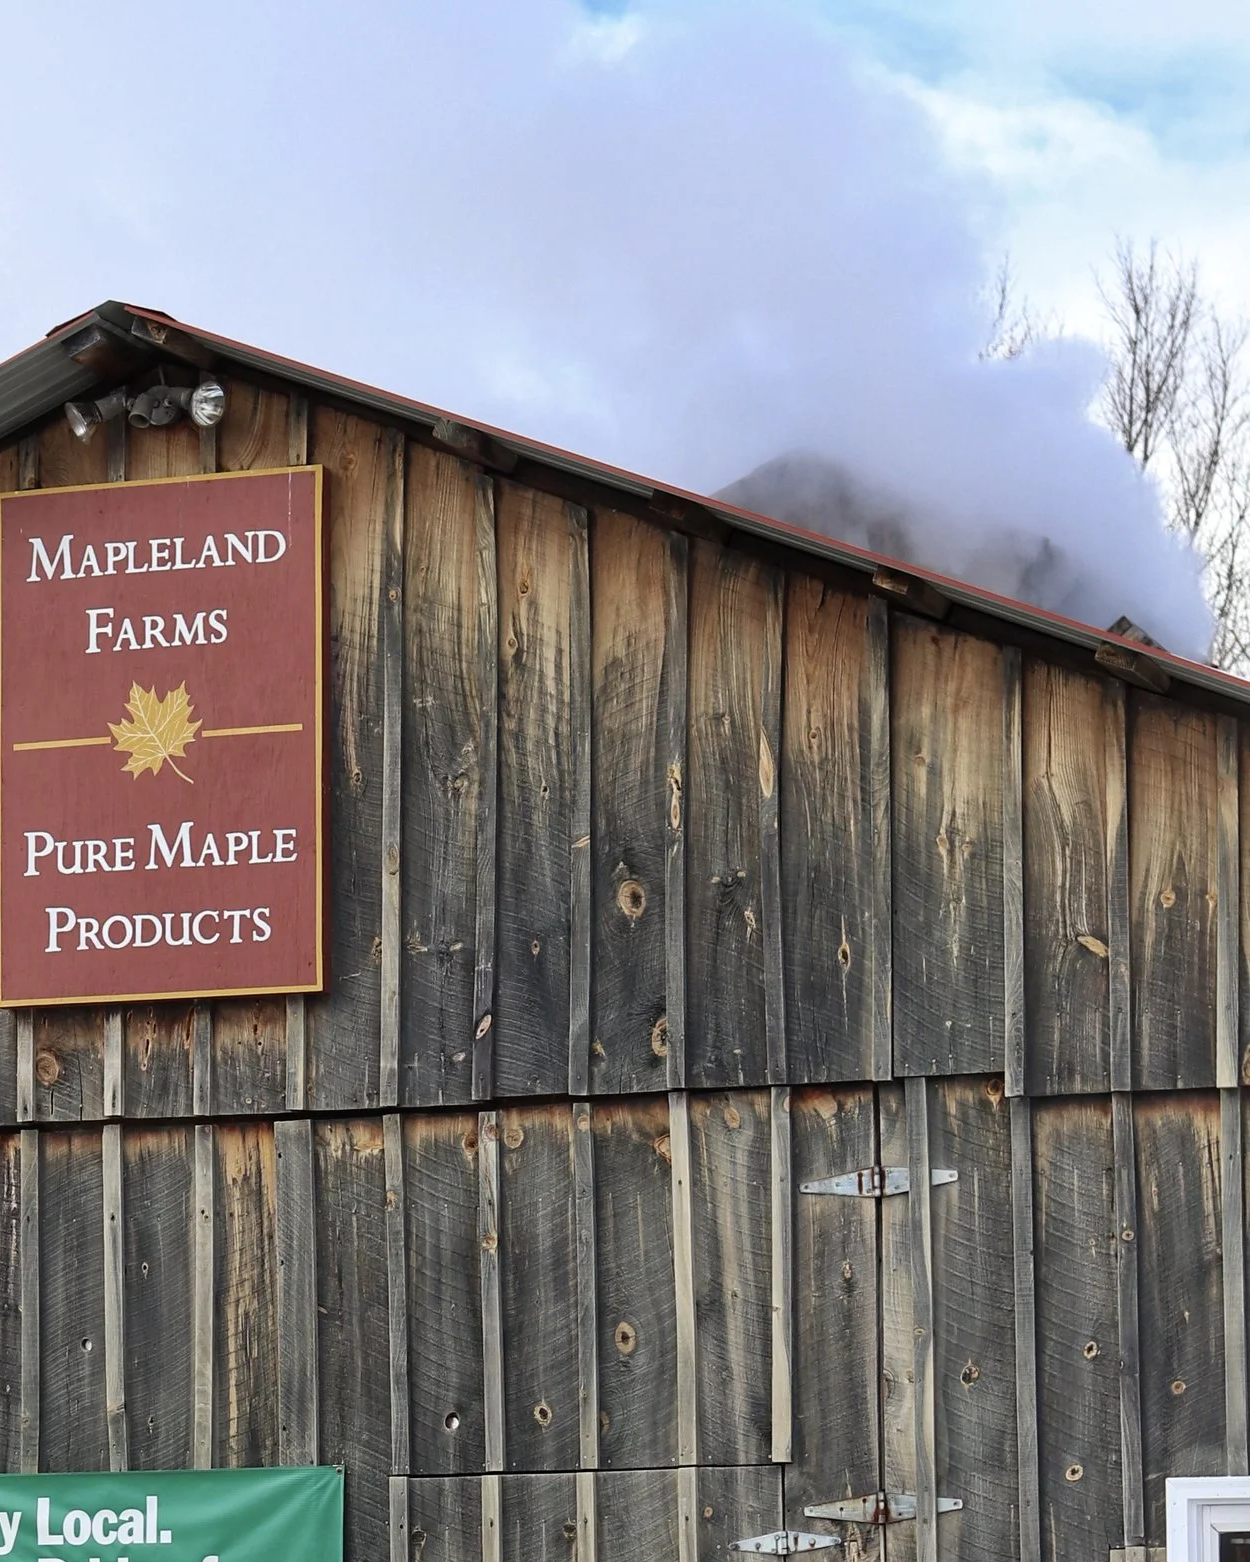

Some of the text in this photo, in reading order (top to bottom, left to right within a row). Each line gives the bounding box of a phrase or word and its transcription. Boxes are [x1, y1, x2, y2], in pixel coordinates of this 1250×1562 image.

[26, 529, 287, 583] MAPLELAND
[85, 608, 228, 655] FARMS
[23, 821, 299, 878] PURE MAPLE
[45, 906, 272, 953] PRODUCTS
[36, 1495, 172, 1546] Local.
